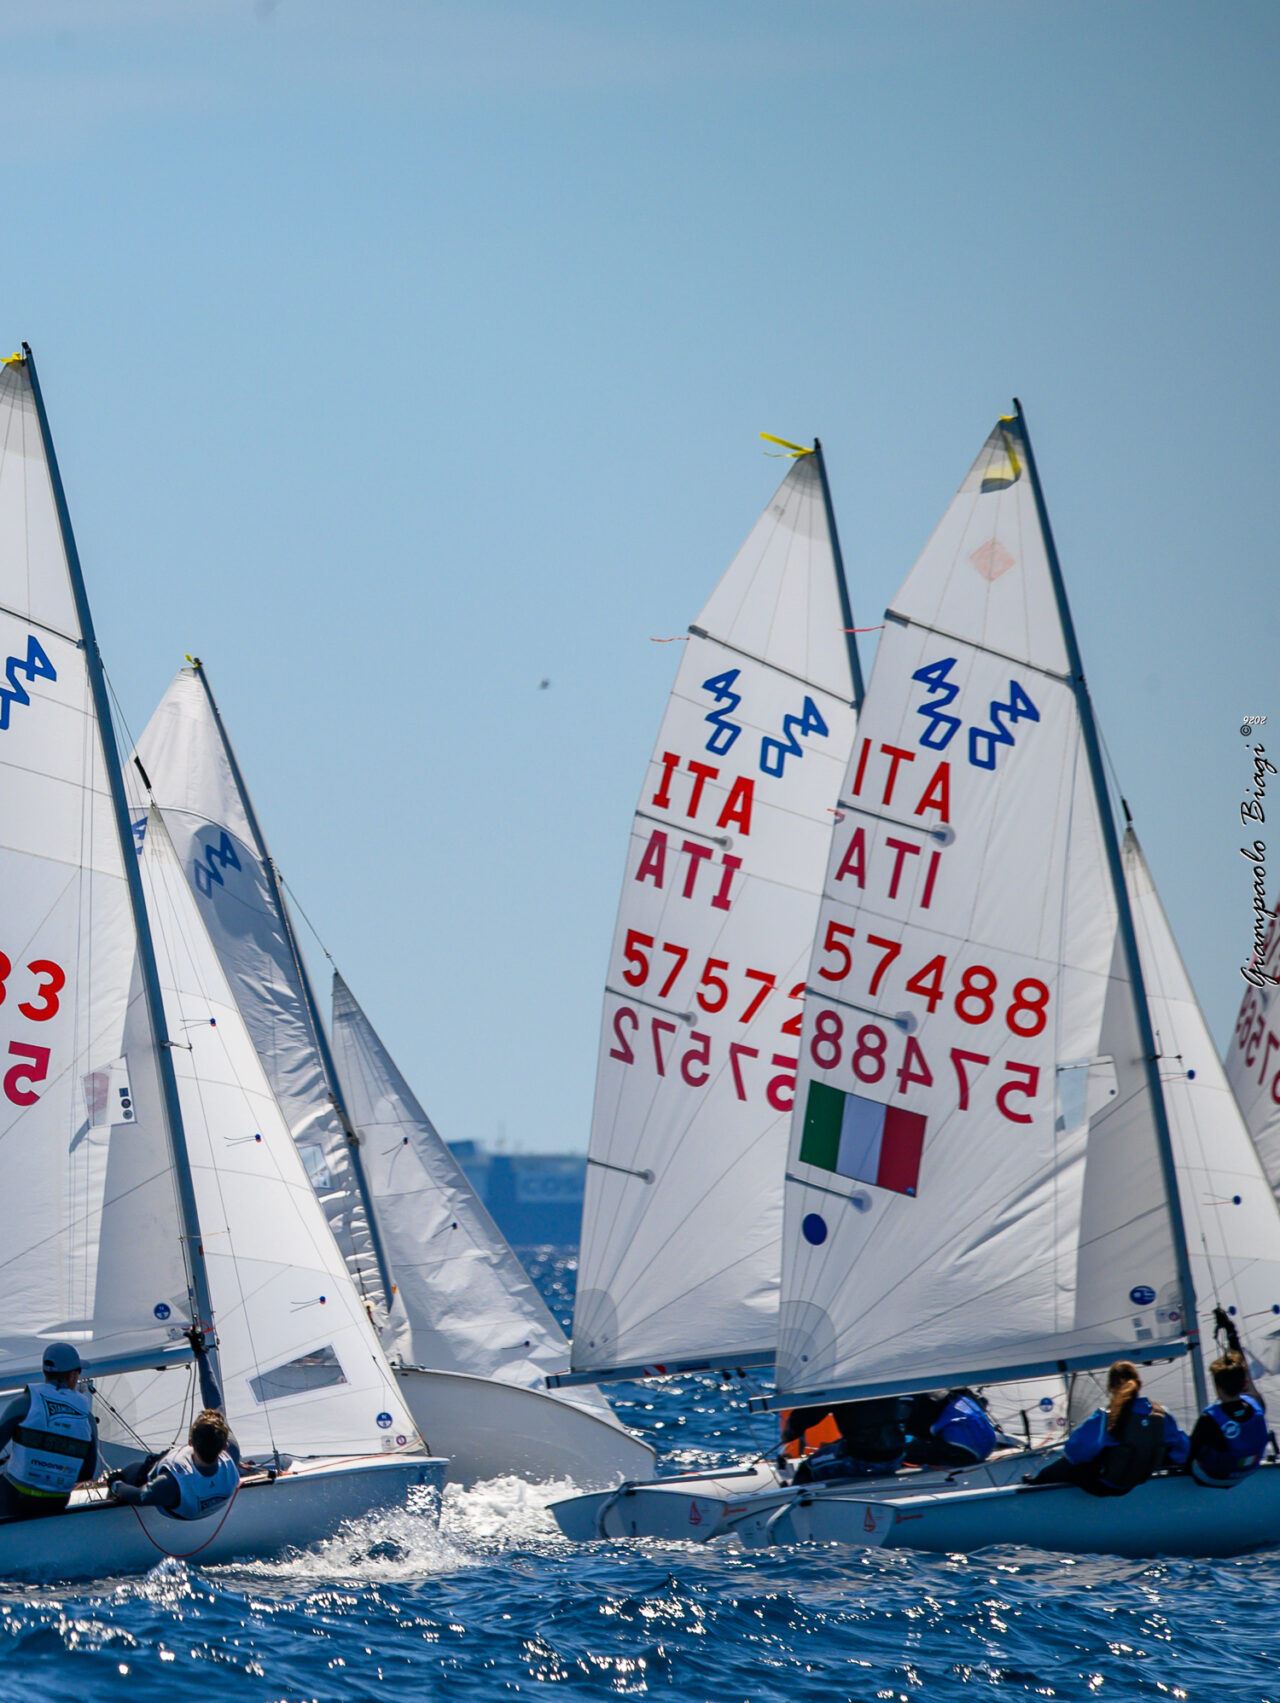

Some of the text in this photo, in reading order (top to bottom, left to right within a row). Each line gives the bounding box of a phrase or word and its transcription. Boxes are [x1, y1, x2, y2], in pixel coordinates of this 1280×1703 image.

[702, 668, 741, 756] 420
[912, 657, 960, 751] 420
[652, 750, 756, 837] ITA
[852, 737, 951, 824] ITA
[818, 920, 1051, 1038] 57488
